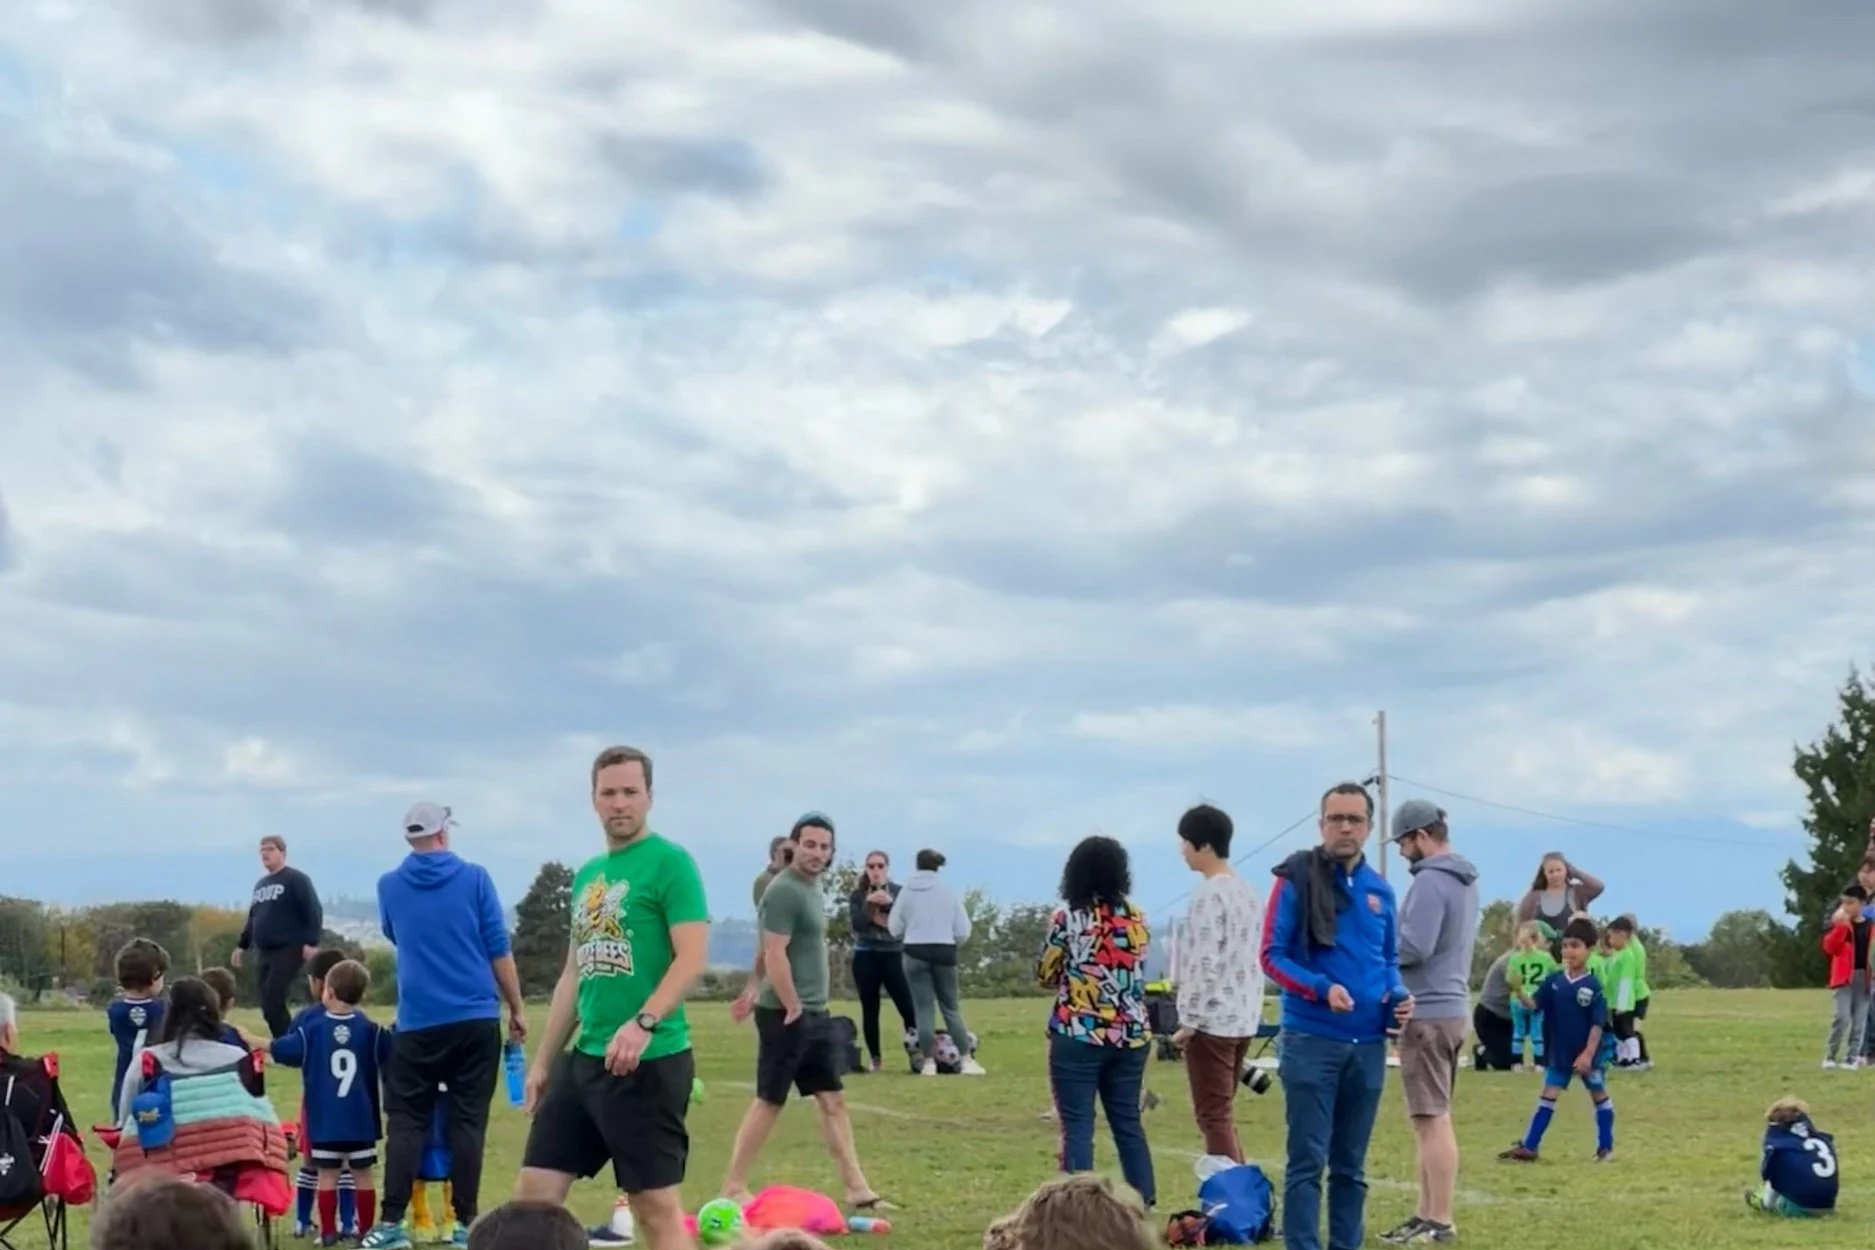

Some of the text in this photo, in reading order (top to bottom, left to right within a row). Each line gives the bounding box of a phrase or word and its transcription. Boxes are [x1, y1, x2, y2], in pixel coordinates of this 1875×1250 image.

[1520, 963, 1544, 985] 12
[331, 1048, 357, 1098] 9
[1803, 1137, 1836, 1178] 3
